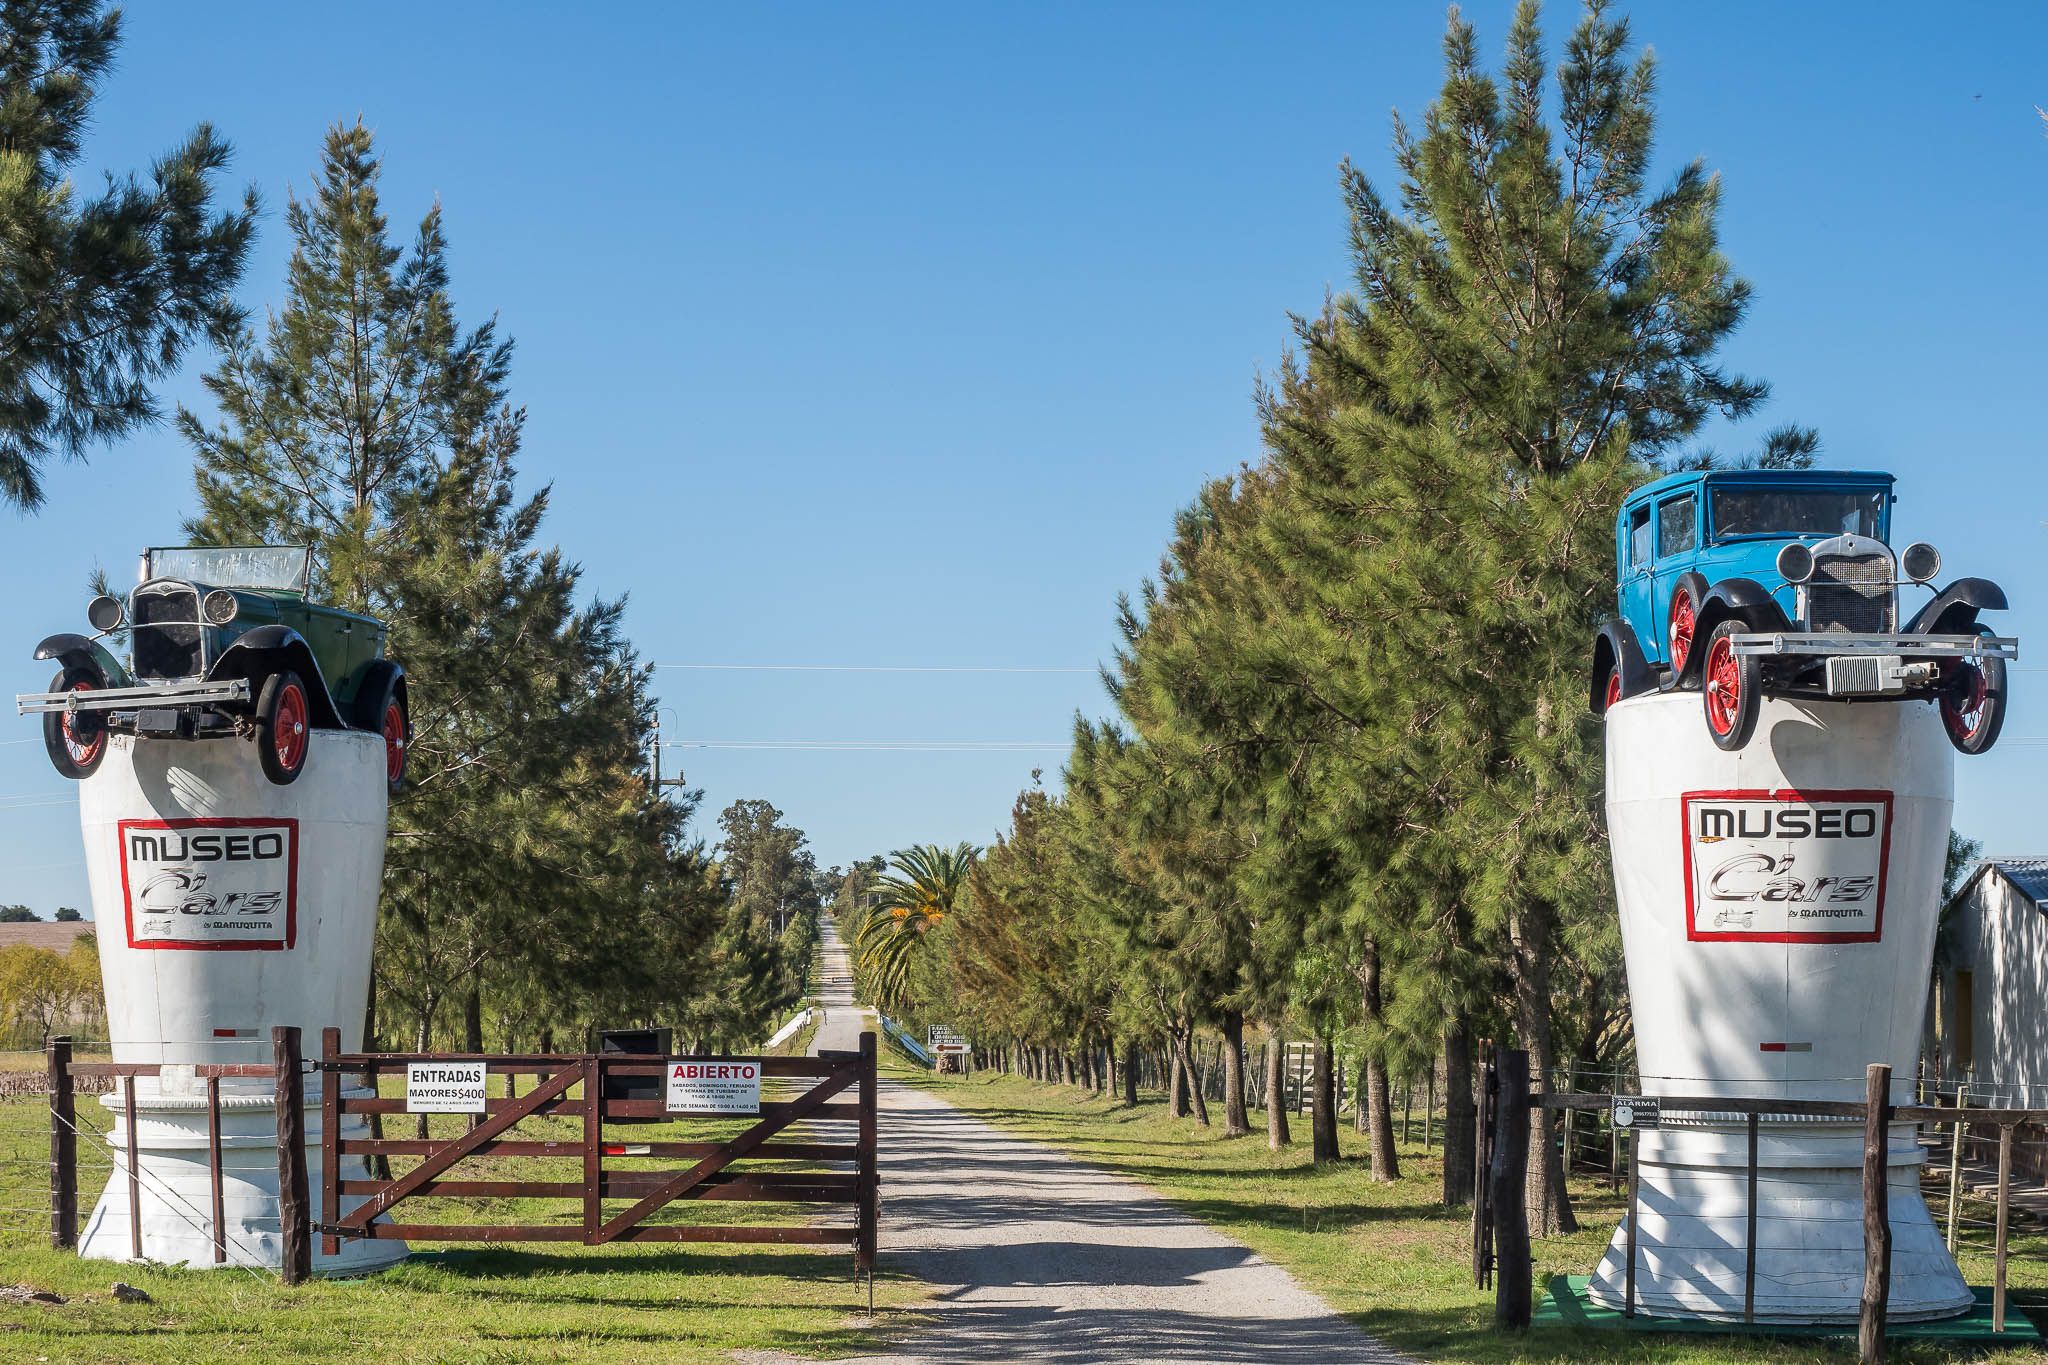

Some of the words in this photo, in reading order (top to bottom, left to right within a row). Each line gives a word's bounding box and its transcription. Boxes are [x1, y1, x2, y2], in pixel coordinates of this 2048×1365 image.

[1700, 808, 1876, 838] MUSEO
[131, 833, 283, 862] MUSEO
[1799, 908, 1864, 918] MANUQUITA
[213, 921, 273, 929] MANUQUITA
[412, 1070, 481, 1083] ENTRADAS
[673, 1065, 755, 1079] ABIERTO
[409, 1089, 458, 1098] MAYORES
[458, 1088, 485, 1100] $400
